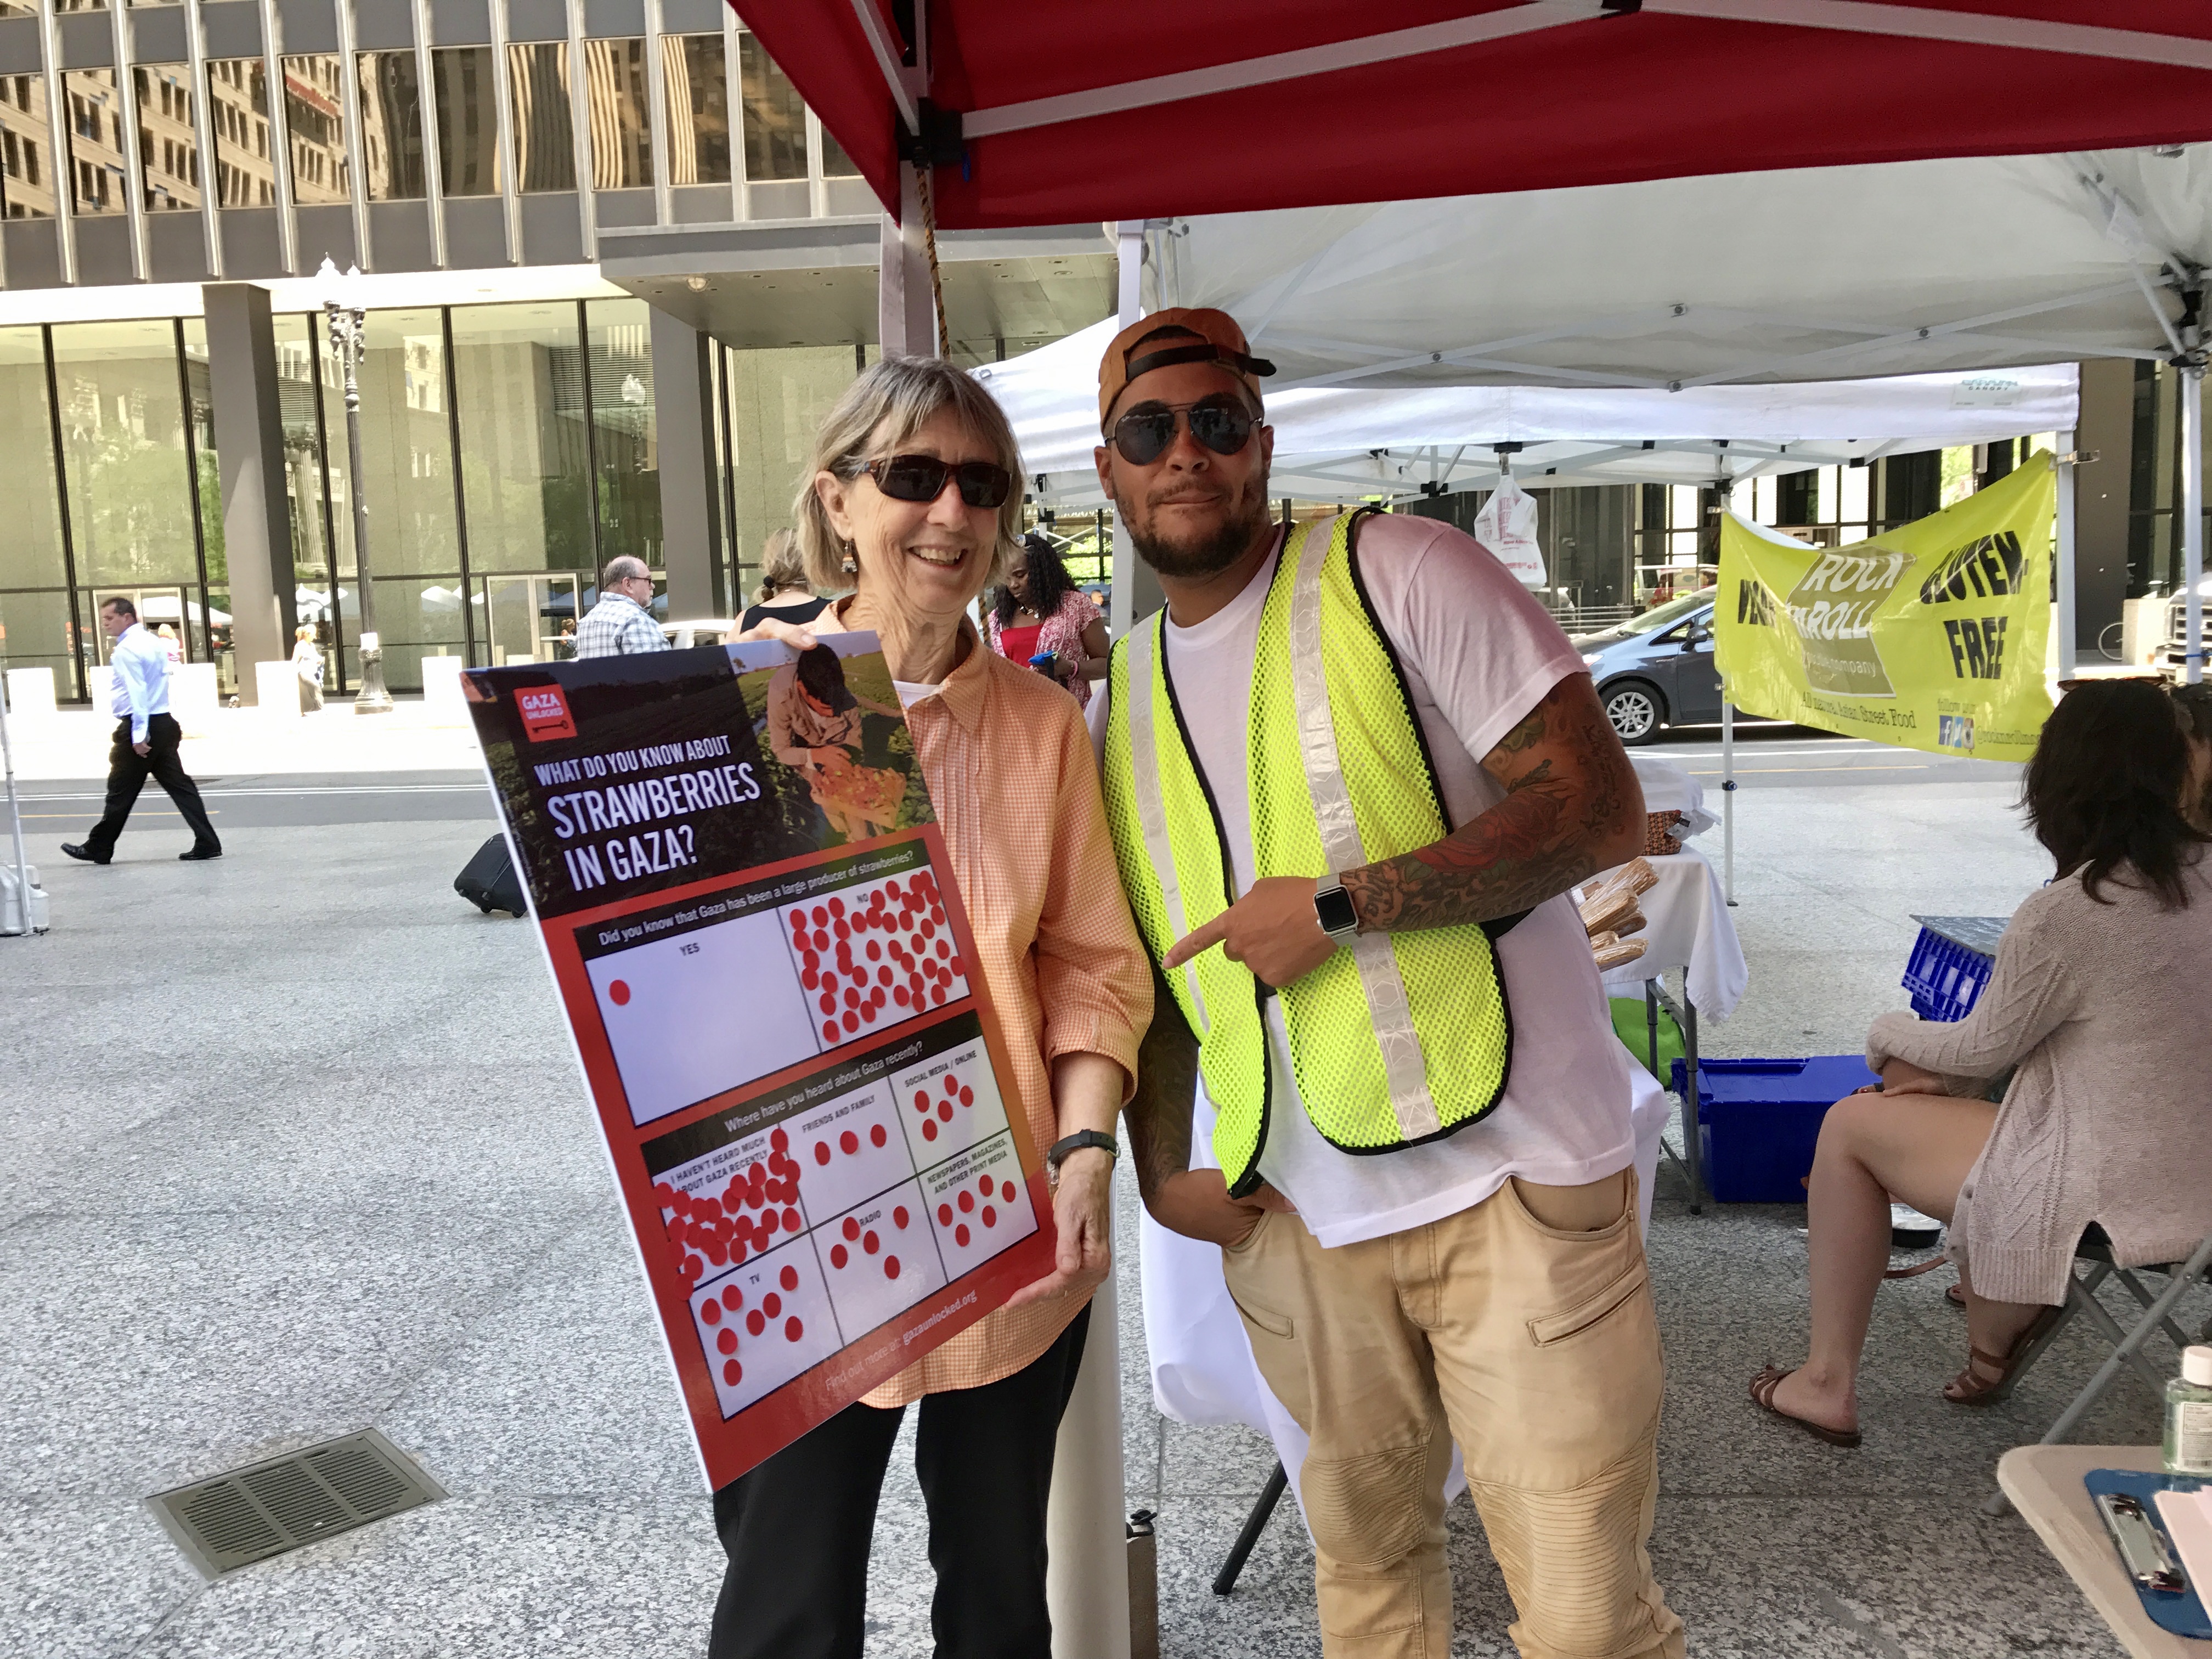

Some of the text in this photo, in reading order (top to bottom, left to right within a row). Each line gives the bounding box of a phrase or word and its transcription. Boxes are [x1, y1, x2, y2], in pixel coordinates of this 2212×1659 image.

[1801, 553, 1903, 592] ROCK
[1807, 600, 1868, 640] ROLL
[1943, 616, 2008, 679] FREE
[1830, 658, 1876, 678] company
[522, 693, 560, 709] GAZA
[526, 707, 563, 720] UNLOCKED
[1860, 706, 1889, 725] Street
[1889, 709, 1916, 729] Food
[534, 735, 731, 786] WHAT DO YOU KNOW ABOUT
[548, 763, 760, 838] STRAWBERRIES
[564, 825, 697, 891] IN GAZA?
[599, 850, 913, 945] Did you know that Gaza has been a large producer of strawberries?
[856, 893, 868, 903] NO
[679, 943, 699, 956] YES
[724, 1041, 923, 1132] Where have you heard about Gaza recently?
[905, 1072, 928, 1087] SOCIAL
[955, 1050, 977, 1065] ONLINE
[802, 1095, 875, 1133] FRIENDS AND FAMILY
[670, 1176, 675, 1184] I
[713, 1148, 740, 1165] HEARD
[741, 1136, 765, 1152] MUCH
[706, 1167, 728, 1183] GAZA
[935, 1150, 1007, 1194] AND OTHER PRINT MEDIA
[859, 1210, 882, 1228] RADIO
[749, 1273, 760, 1285] TV
[825, 1372, 846, 1391] Find
[849, 1362, 864, 1378] out
[865, 1347, 888, 1366] more
[902, 1290, 977, 1345] gazaunlocked.org
